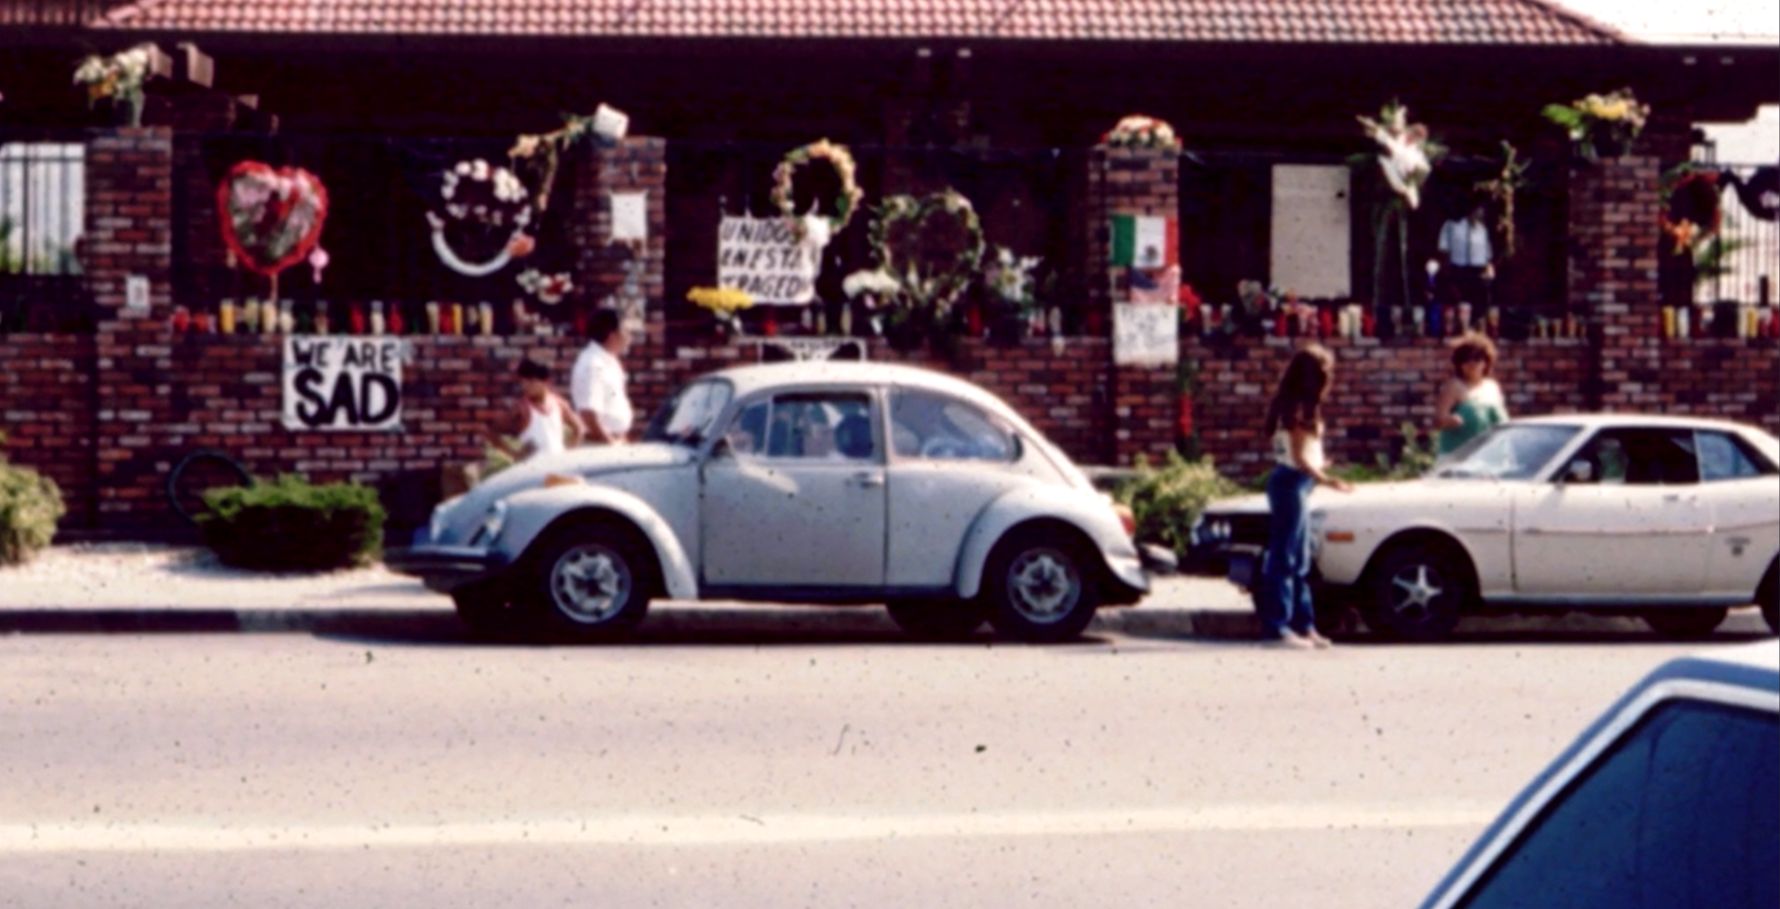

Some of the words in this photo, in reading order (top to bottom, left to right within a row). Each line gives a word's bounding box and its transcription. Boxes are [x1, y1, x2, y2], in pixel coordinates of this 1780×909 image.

[291, 339, 330, 368] WE
[343, 340, 397, 372] ARE
[293, 366, 400, 427] SAD
